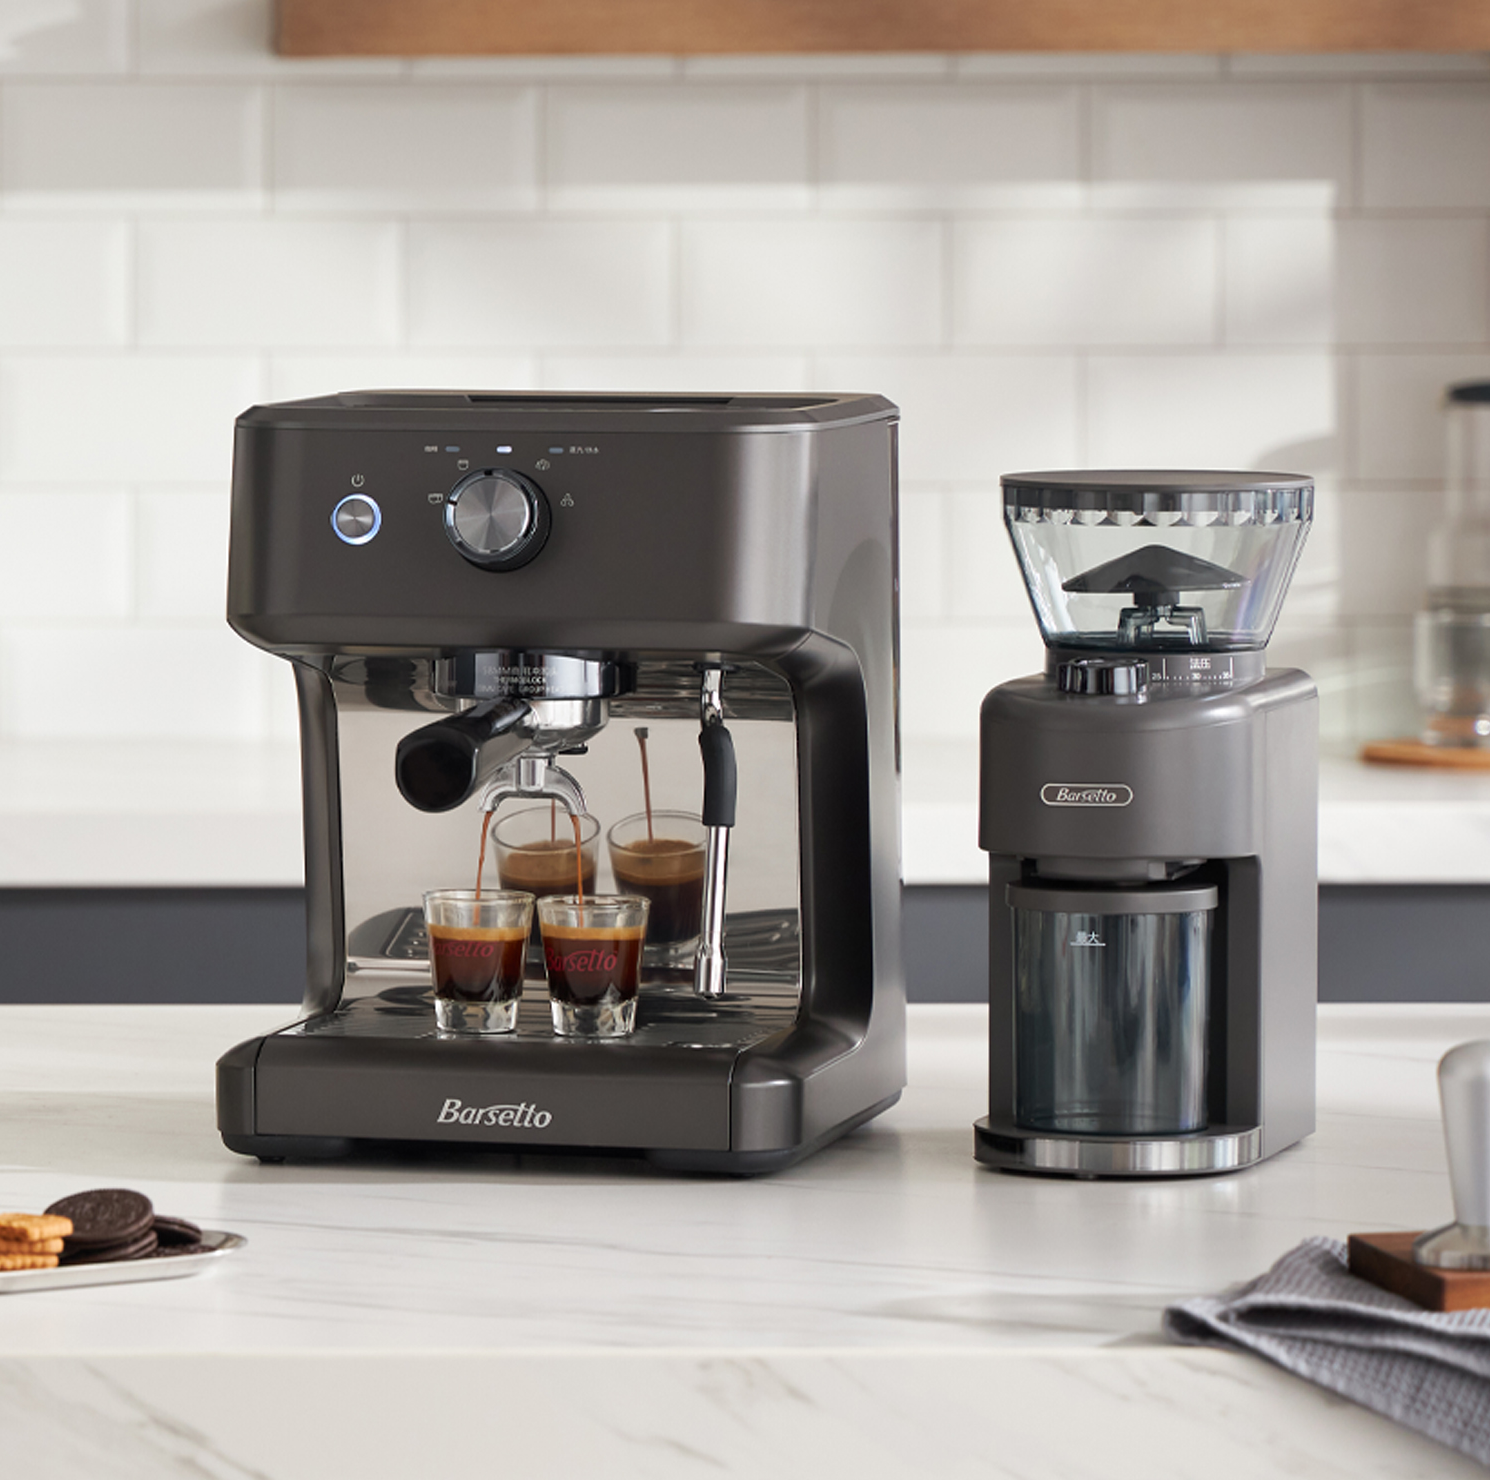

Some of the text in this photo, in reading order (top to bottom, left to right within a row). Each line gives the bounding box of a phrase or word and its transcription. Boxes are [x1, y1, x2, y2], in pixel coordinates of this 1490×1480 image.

[1056, 786, 1118, 803] Barsetto
[546, 948, 617, 972] Barsetto
[437, 1098, 553, 1129] Barsetto
